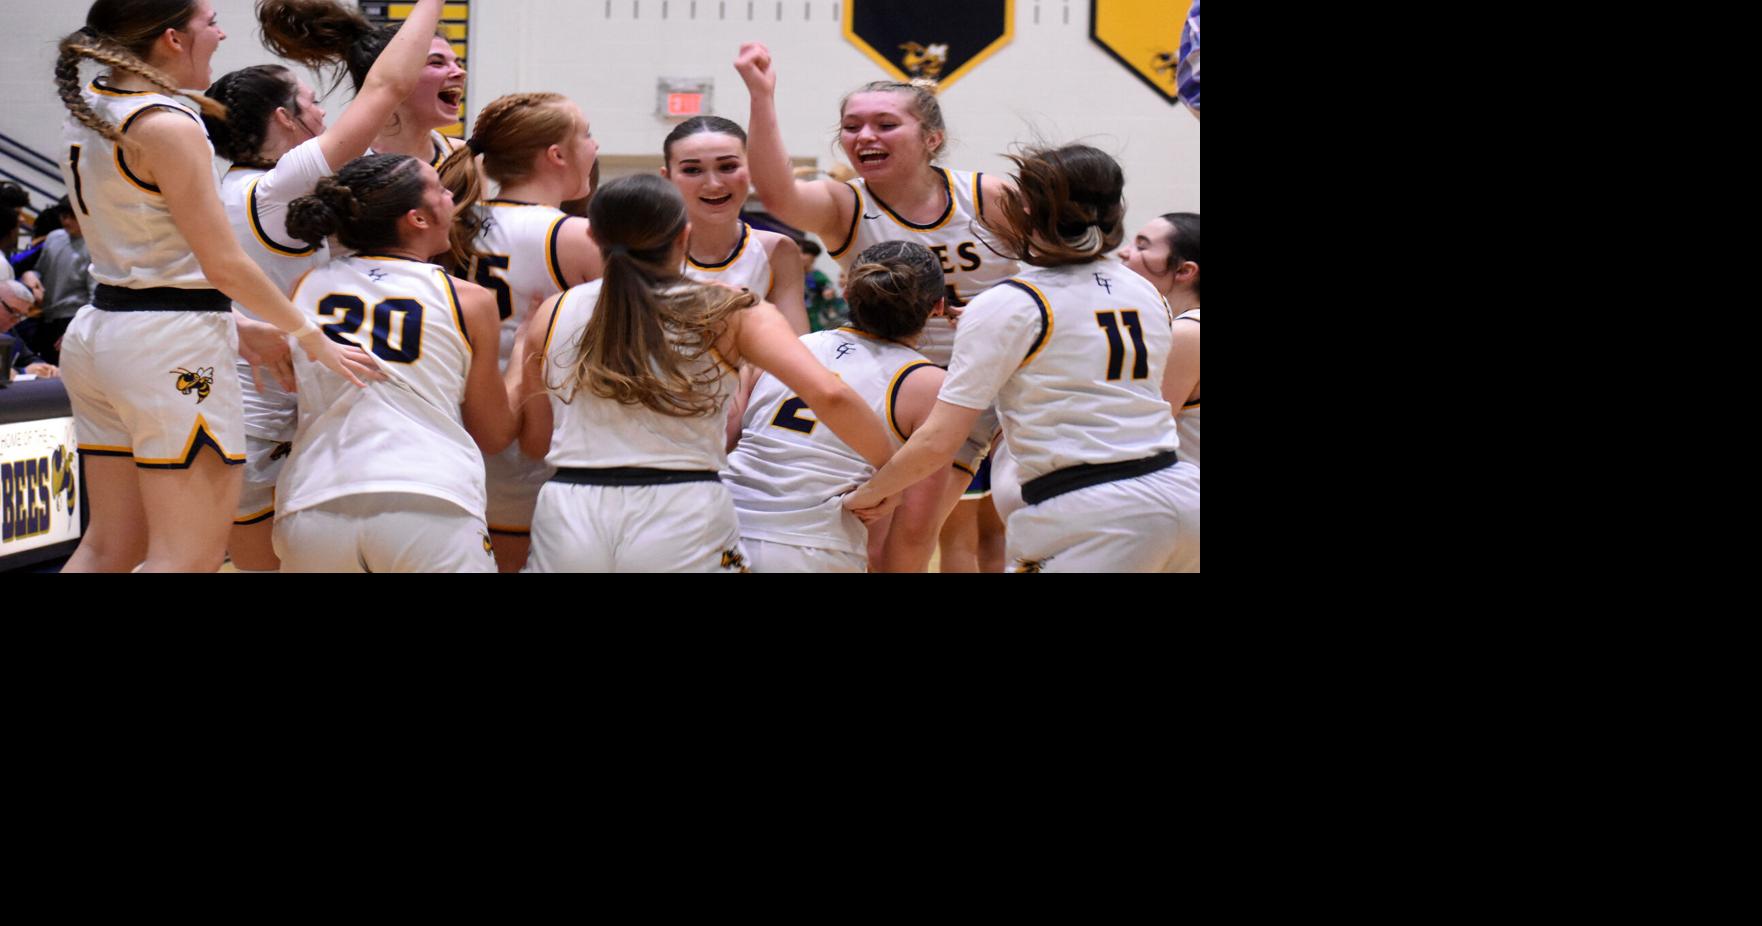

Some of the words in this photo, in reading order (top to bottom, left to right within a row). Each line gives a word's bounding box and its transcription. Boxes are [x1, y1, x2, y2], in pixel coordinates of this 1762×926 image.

[69, 144, 90, 216] 1
[928, 242, 982, 274] ES
[316, 290, 426, 366] 20
[1094, 307, 1149, 382] 11
[1, 456, 50, 542] BEES
